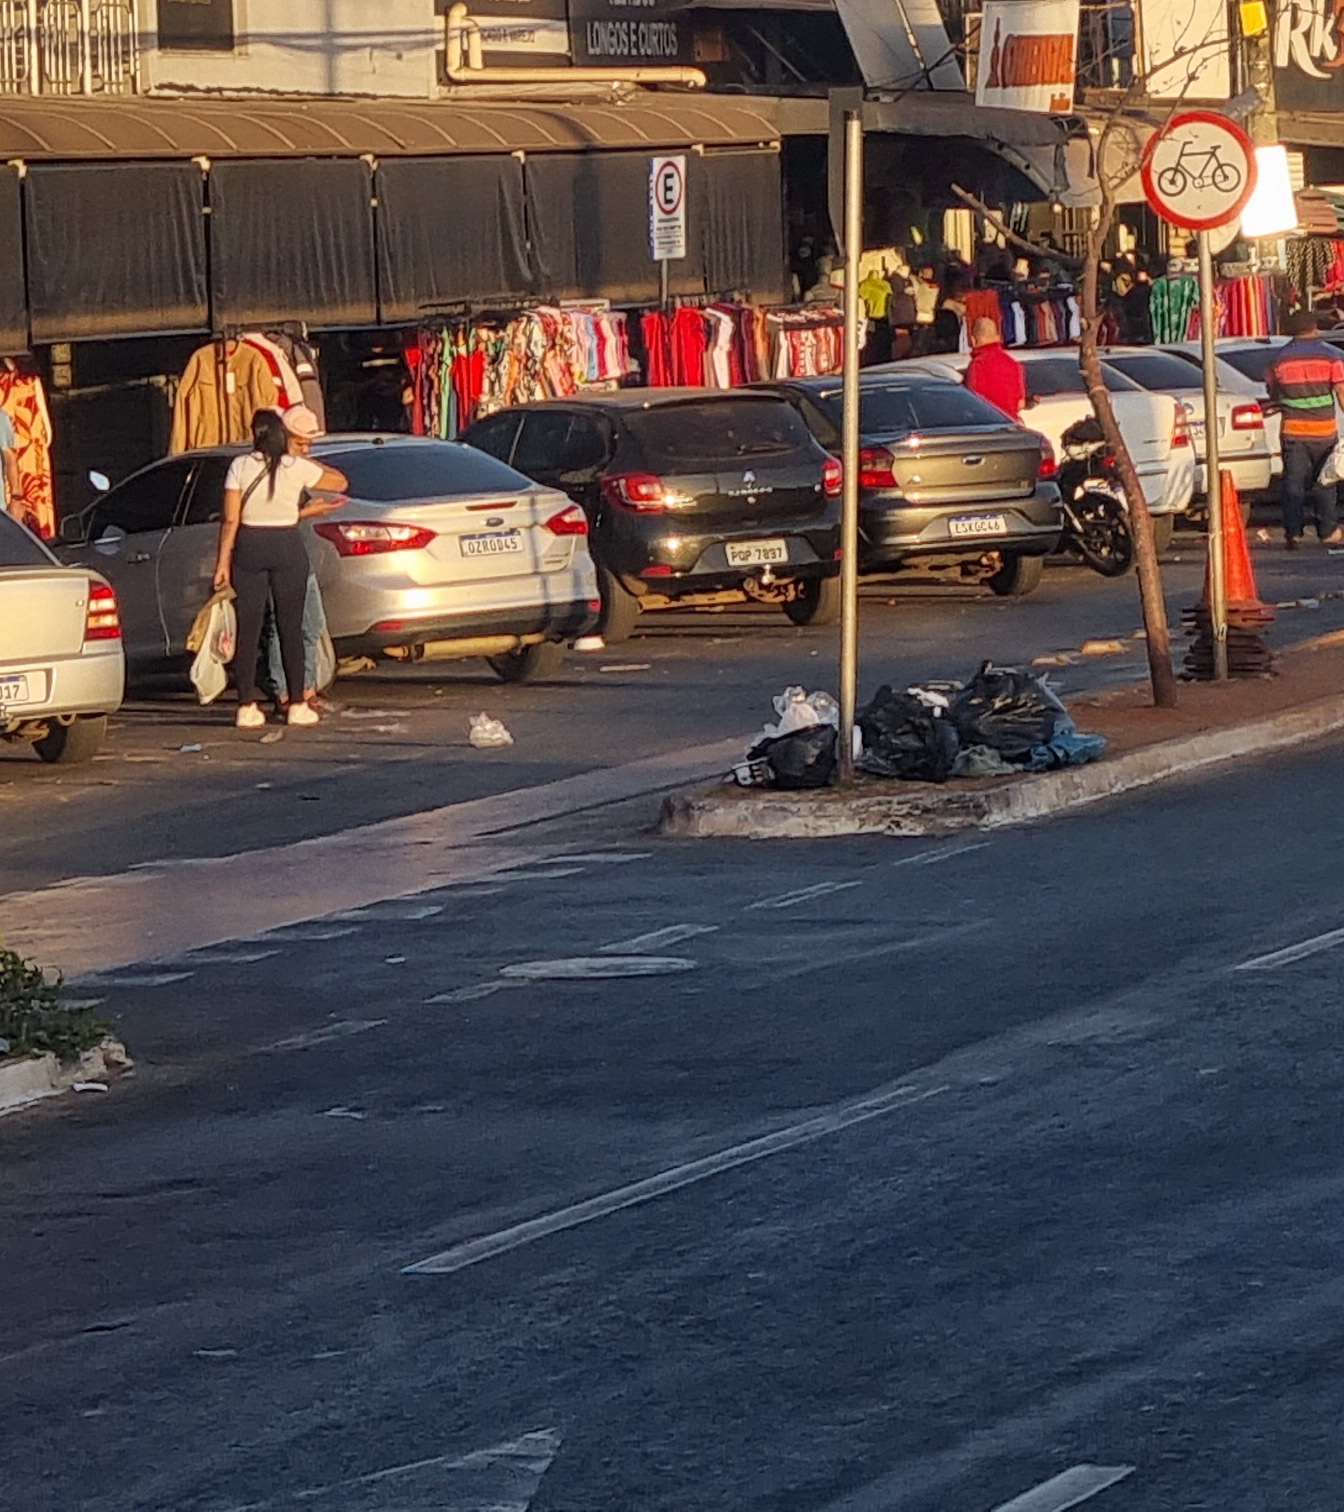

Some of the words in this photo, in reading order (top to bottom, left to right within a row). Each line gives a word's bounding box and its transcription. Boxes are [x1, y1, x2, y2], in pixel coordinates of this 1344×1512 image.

[586, 21, 629, 56] LONGOS
[638, 21, 678, 56] CURTOS
[664, 173, 675, 205] E
